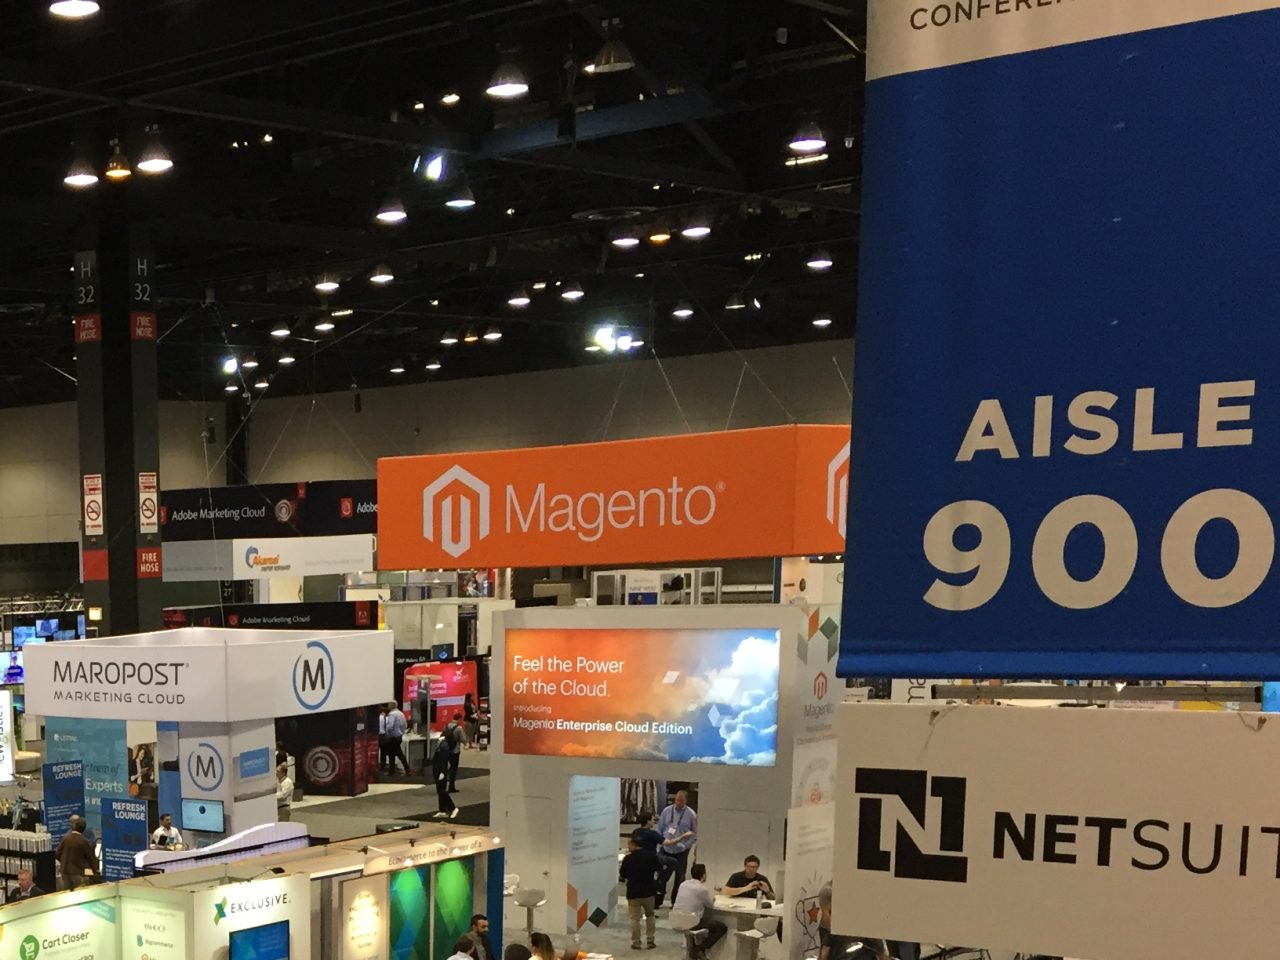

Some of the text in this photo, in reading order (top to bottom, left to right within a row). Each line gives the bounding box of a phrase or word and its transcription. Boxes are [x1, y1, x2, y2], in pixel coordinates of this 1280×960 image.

[78, 285, 95, 304] 32
[134, 282, 151, 301] 32
[955, 380, 1256, 462] AISLE
[172, 505, 266, 521] Adobe Marketing Cloud
[505, 476, 717, 542] Magento
[142, 552, 157, 562] FIRE
[922, 488, 1276, 611] 900
[140, 563, 159, 573] HOSE
[513, 655, 624, 673] Feel the Power
[513, 677, 611, 697] of the Cloud.
[54, 690, 185, 705] MARKETING CLOUD
[556, 718, 613, 733] Enterprise
[615, 720, 650, 733] Cloud
[652, 721, 692, 735] Edition
[84, 778, 124, 793] Experts
[112, 801, 146, 812] REFRESH
[114, 811, 146, 820] LOUNGE
[42, 938, 61, 950] Cart
[62, 930, 90, 945] Closer
